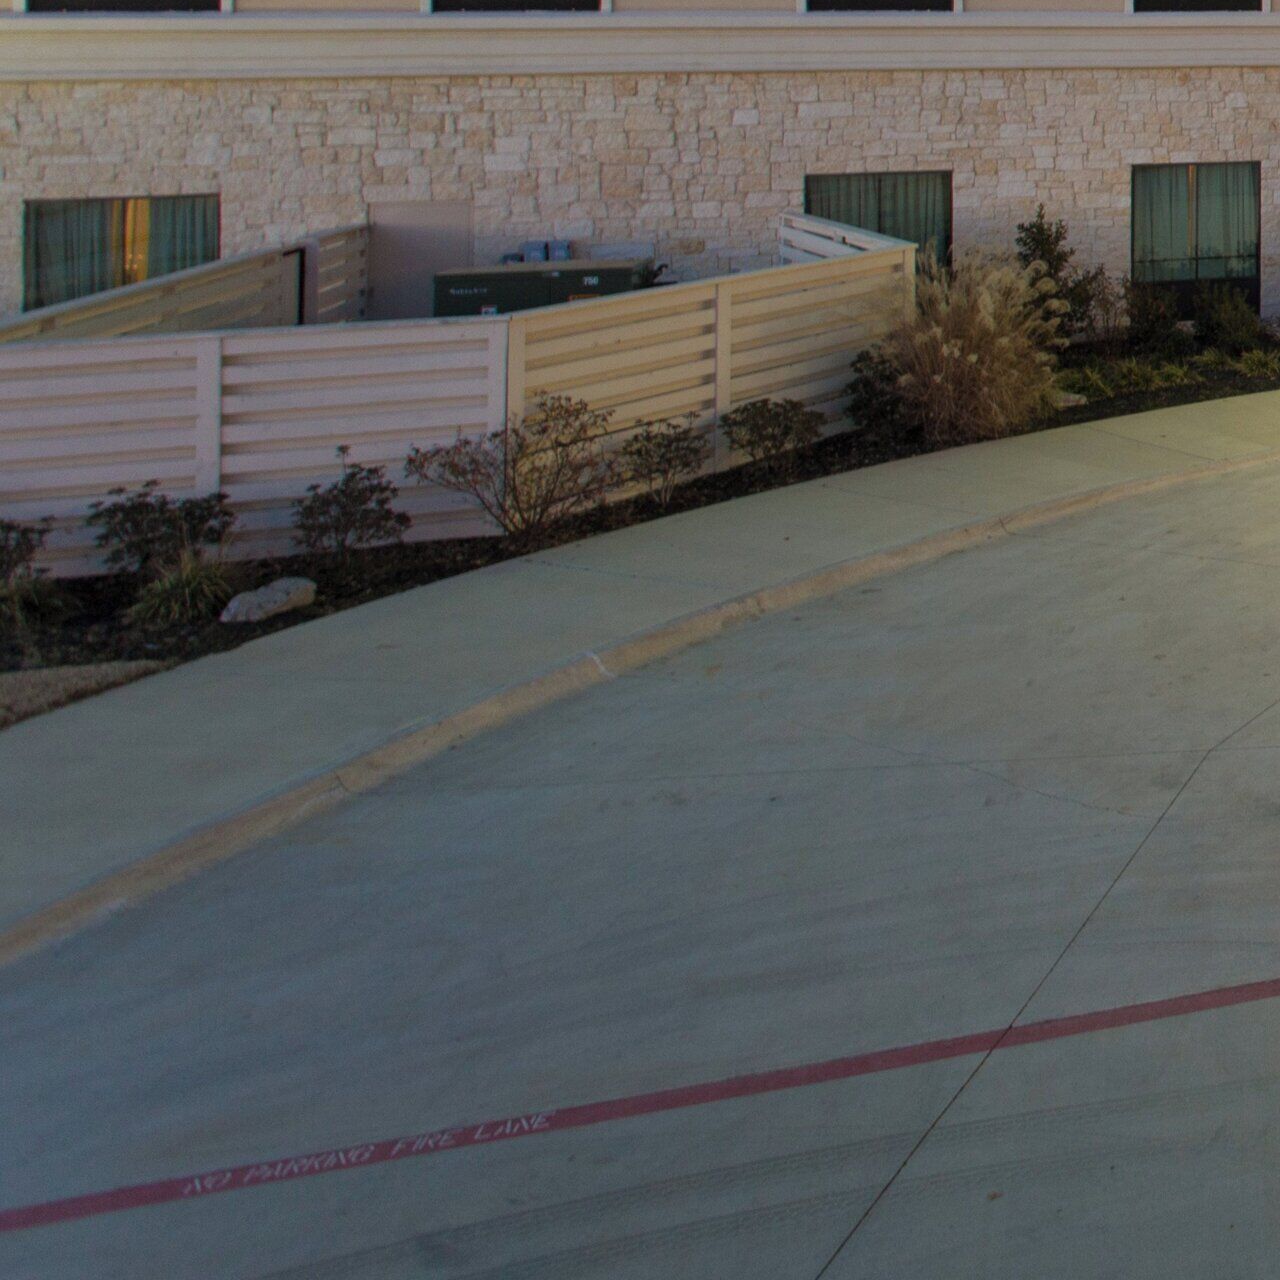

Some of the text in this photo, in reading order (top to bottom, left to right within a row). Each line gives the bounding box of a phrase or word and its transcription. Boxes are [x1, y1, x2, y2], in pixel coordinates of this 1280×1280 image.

[183, 1110, 557, 1196] NO PARKING FIRE LANE
